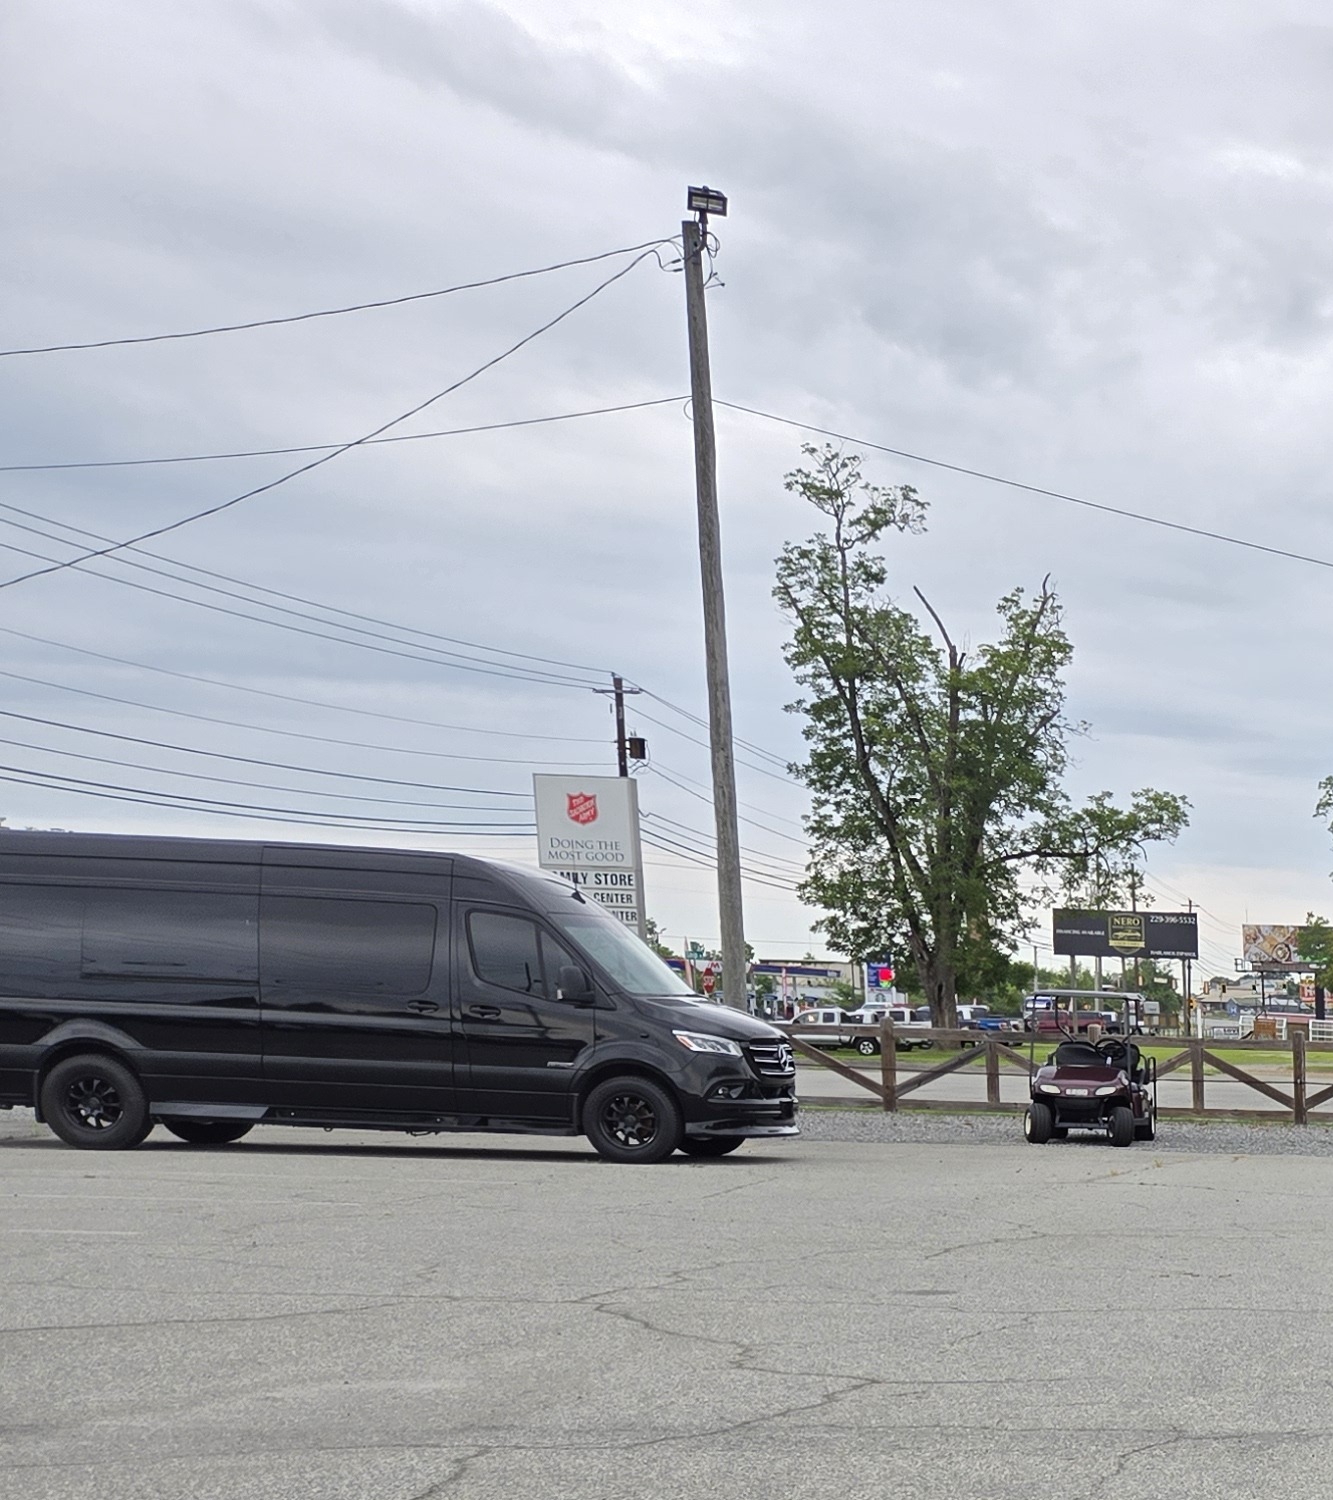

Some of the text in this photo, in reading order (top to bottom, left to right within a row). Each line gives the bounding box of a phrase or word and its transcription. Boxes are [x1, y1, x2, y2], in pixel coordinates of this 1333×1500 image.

[550, 837, 621, 851] DOING THE
[548, 850, 625, 862] MOST GOOD
[552, 871, 635, 886] MILY STORE
[593, 892, 633, 904] CENTER
[1113, 917, 1140, 926] NERO
